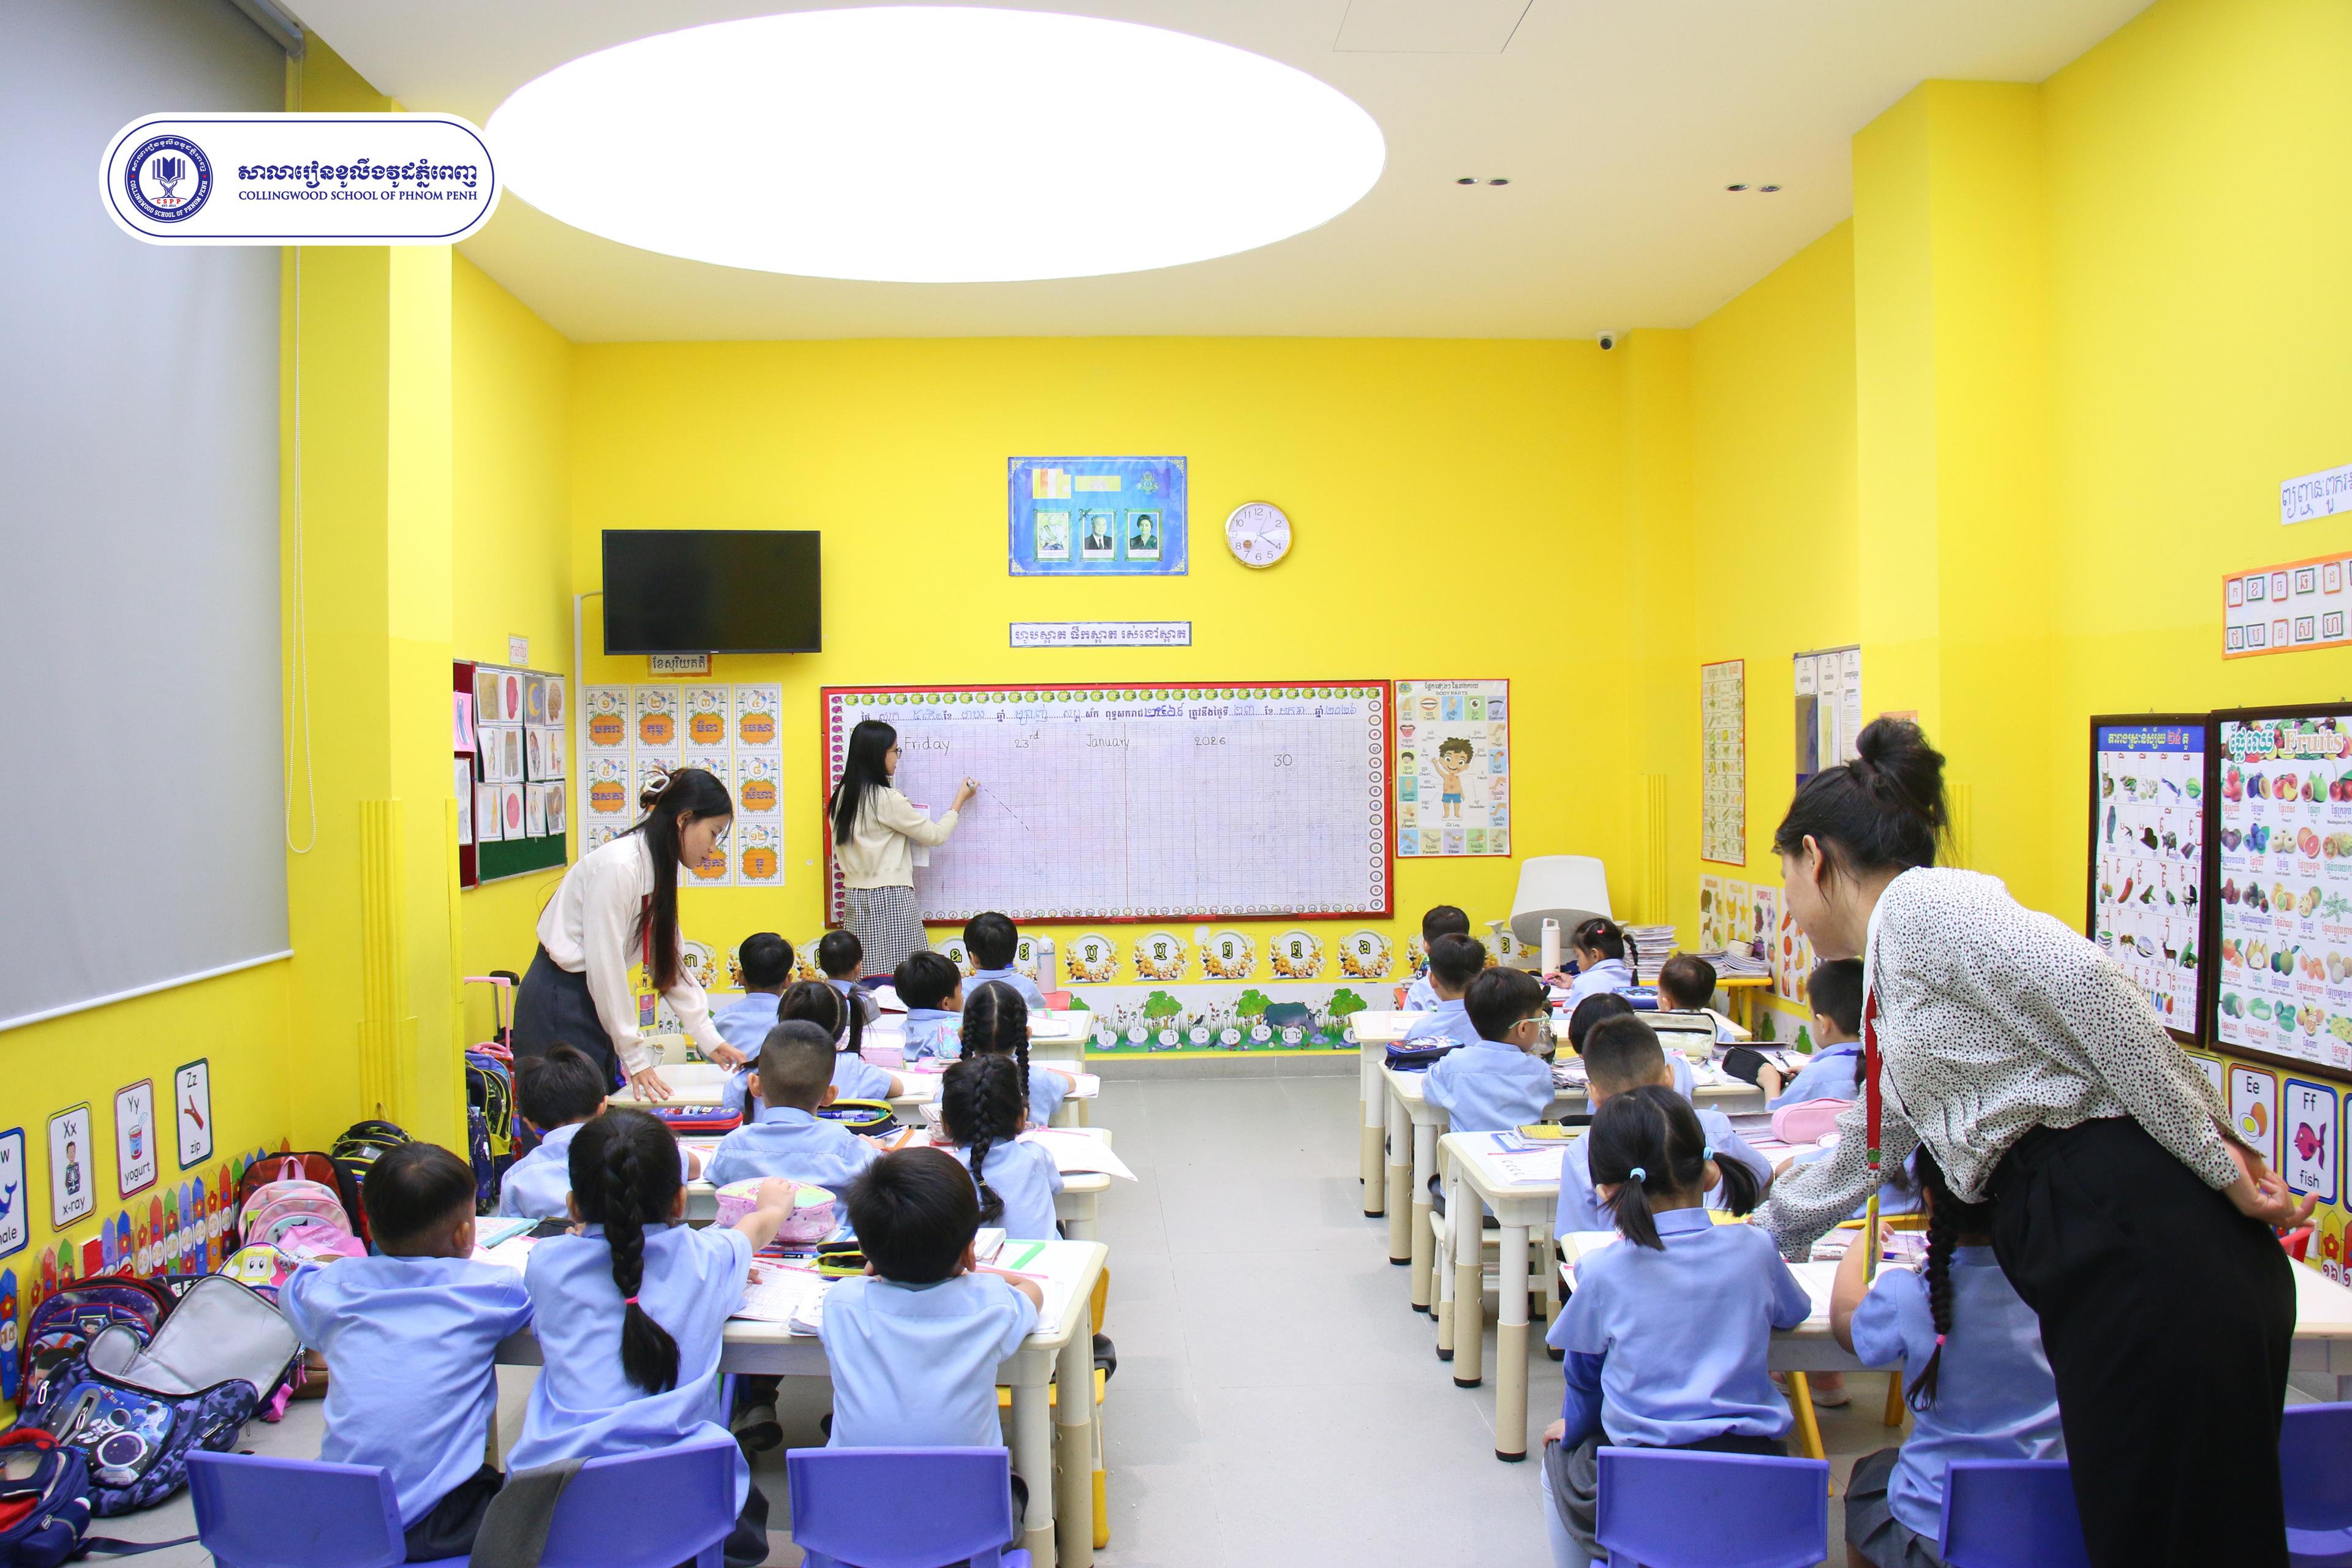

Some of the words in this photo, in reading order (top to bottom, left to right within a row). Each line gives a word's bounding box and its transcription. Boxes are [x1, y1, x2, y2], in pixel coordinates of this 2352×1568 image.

[904, 736, 950, 756] Friday
[1086, 734, 1129, 751] January
[1194, 736, 1226, 745] 2026
[2283, 727, 2343, 753] Fruits
[1274, 754, 1293, 767] 30
[1757, 891, 1771, 901] PURPLE
[187, 1071, 197, 1088] Zz
[2246, 1076, 2260, 1095] Ee
[127, 1096, 140, 1115] Yy
[2304, 1092, 2316, 1112] Ff
[63, 1120, 77, 1139] Xx
[190, 1140, 201, 1155] zip
[125, 1161, 151, 1183] yogurt
[2299, 1169, 2320, 1189] fish
[62, 1197, 86, 1215] x-ray
